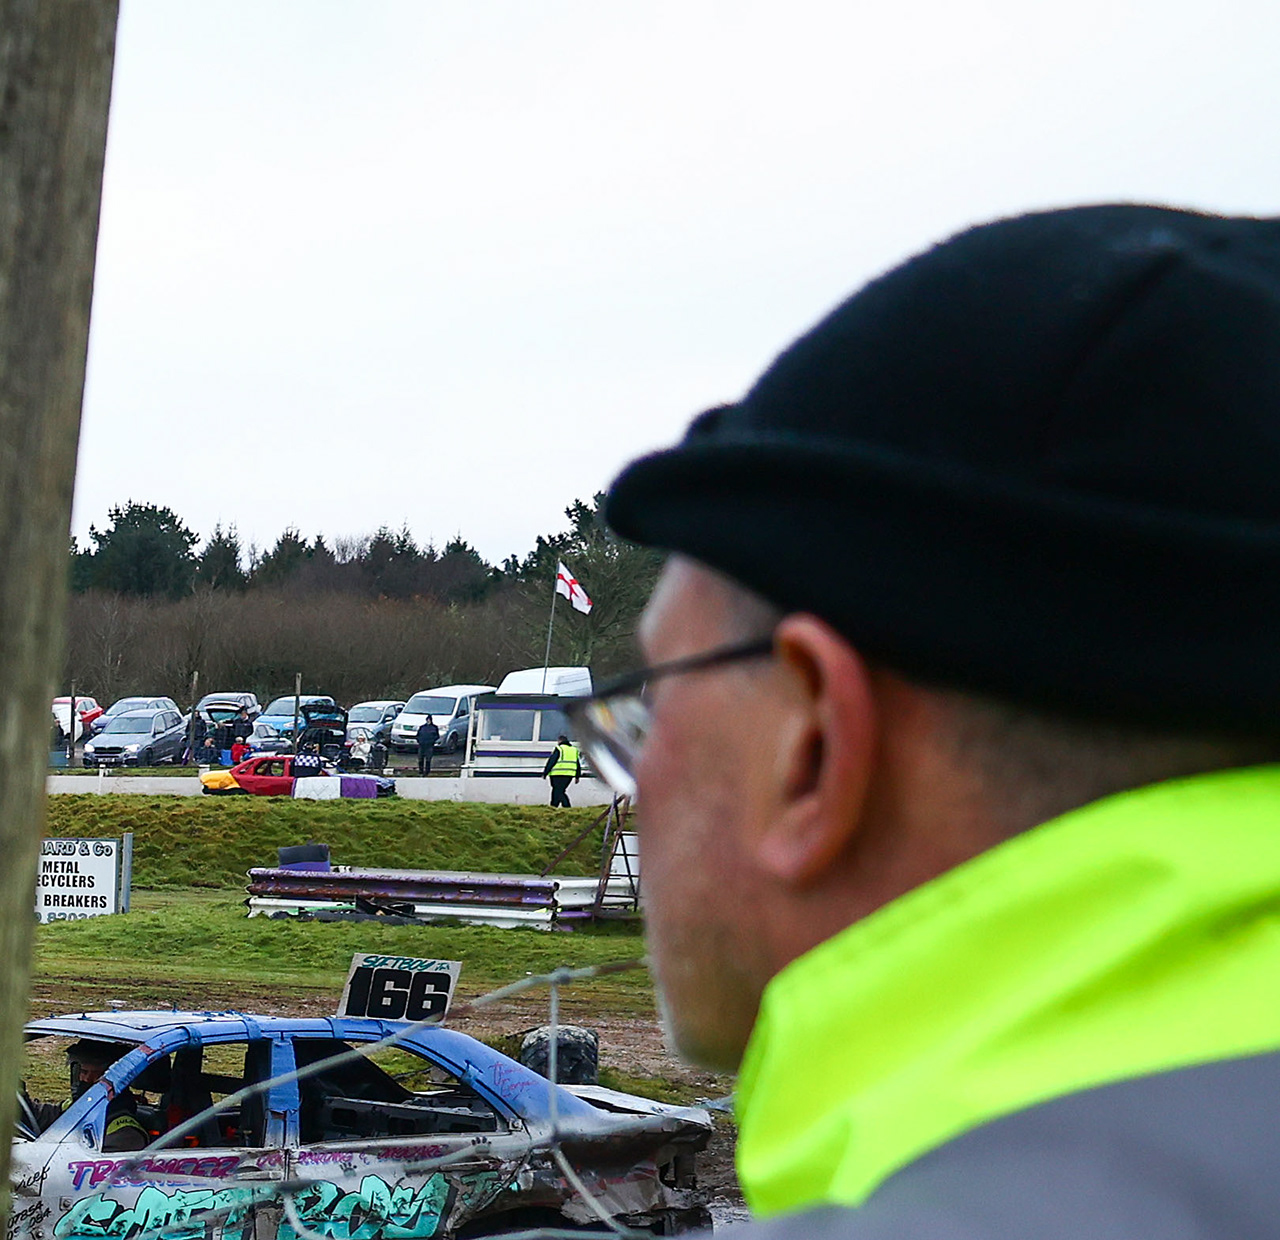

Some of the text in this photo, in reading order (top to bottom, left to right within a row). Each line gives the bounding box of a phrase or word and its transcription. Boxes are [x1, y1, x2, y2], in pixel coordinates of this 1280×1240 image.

[41, 841, 114, 856] ARD & Co
[42, 861, 80, 874] METAL
[37, 875, 95, 888] ECYCLERS
[44, 894, 107, 908] BREAKERS
[345, 966, 451, 1022] 166
